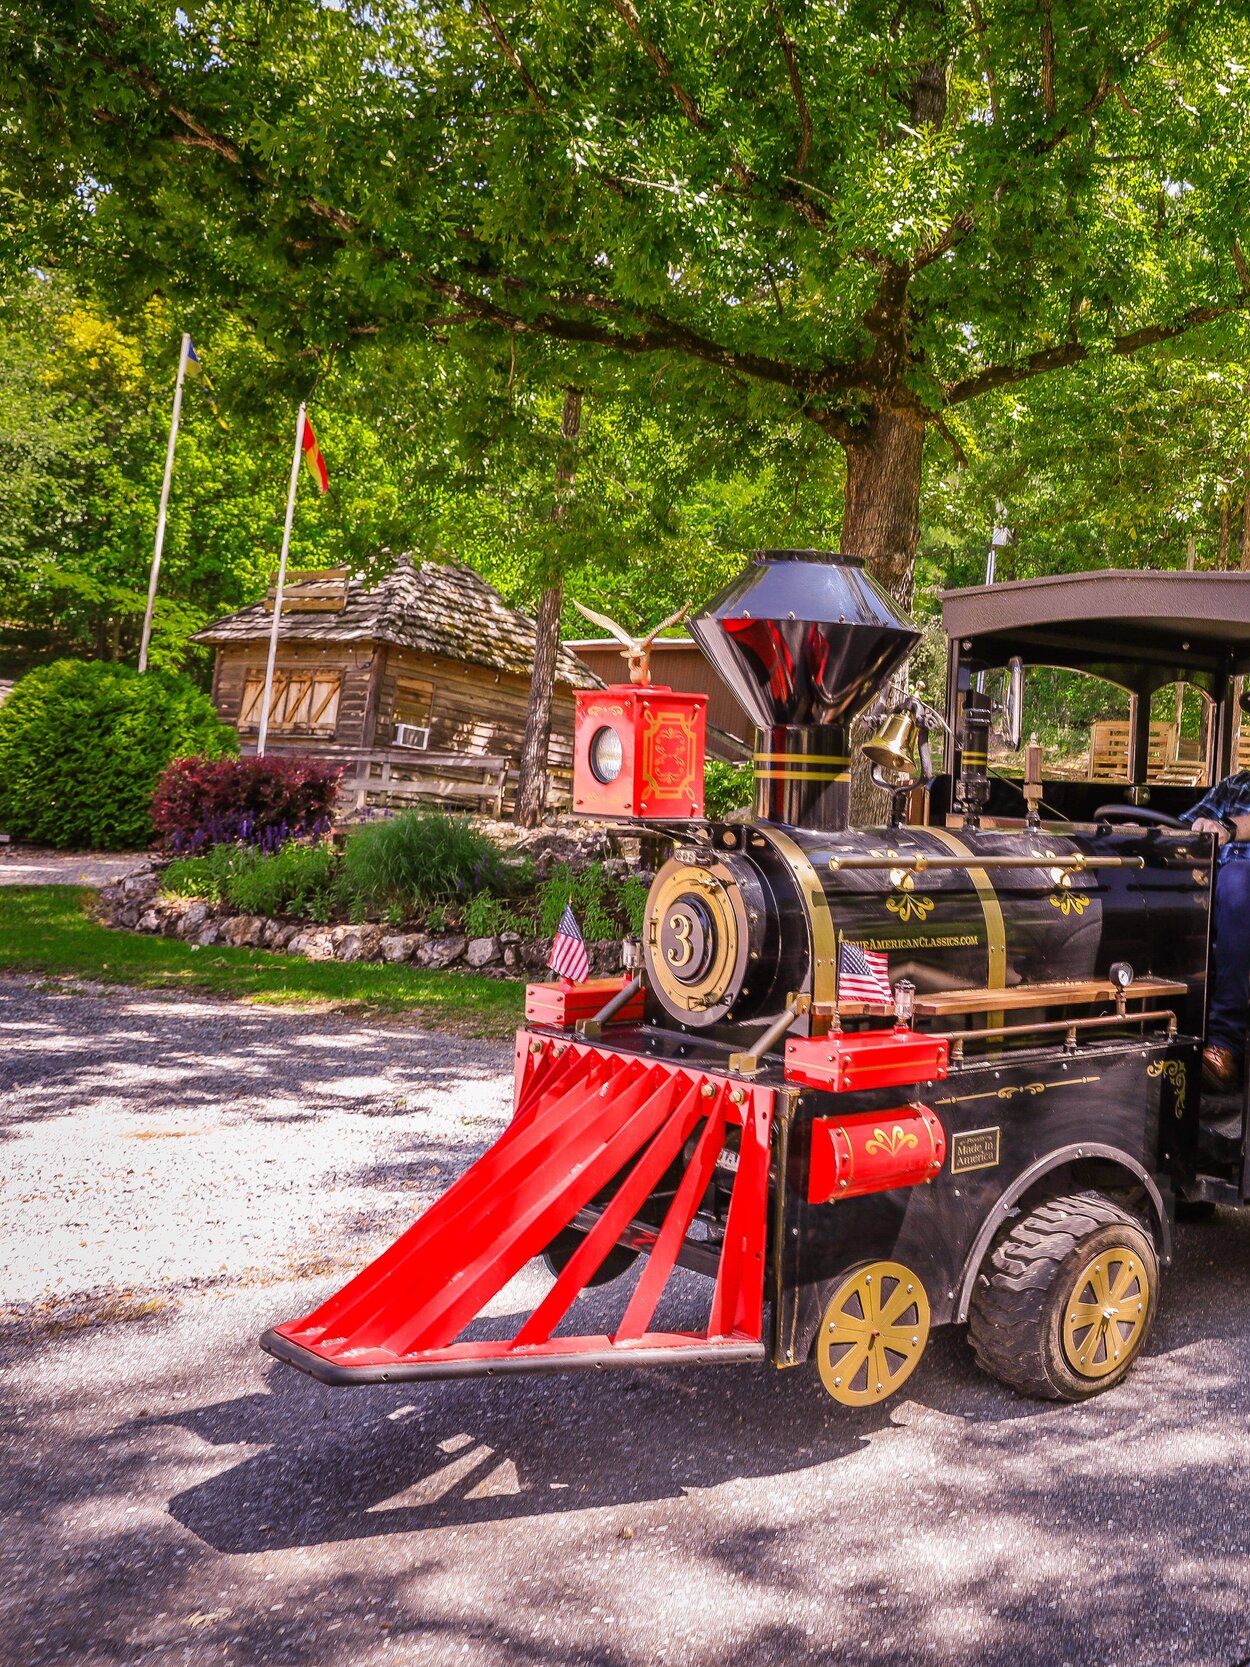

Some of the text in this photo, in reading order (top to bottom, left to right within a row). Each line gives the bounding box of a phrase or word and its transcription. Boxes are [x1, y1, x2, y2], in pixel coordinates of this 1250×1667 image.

[667, 913, 691, 967] 3
[957, 1143, 982, 1156] Made
[957, 1150, 994, 1167] America
